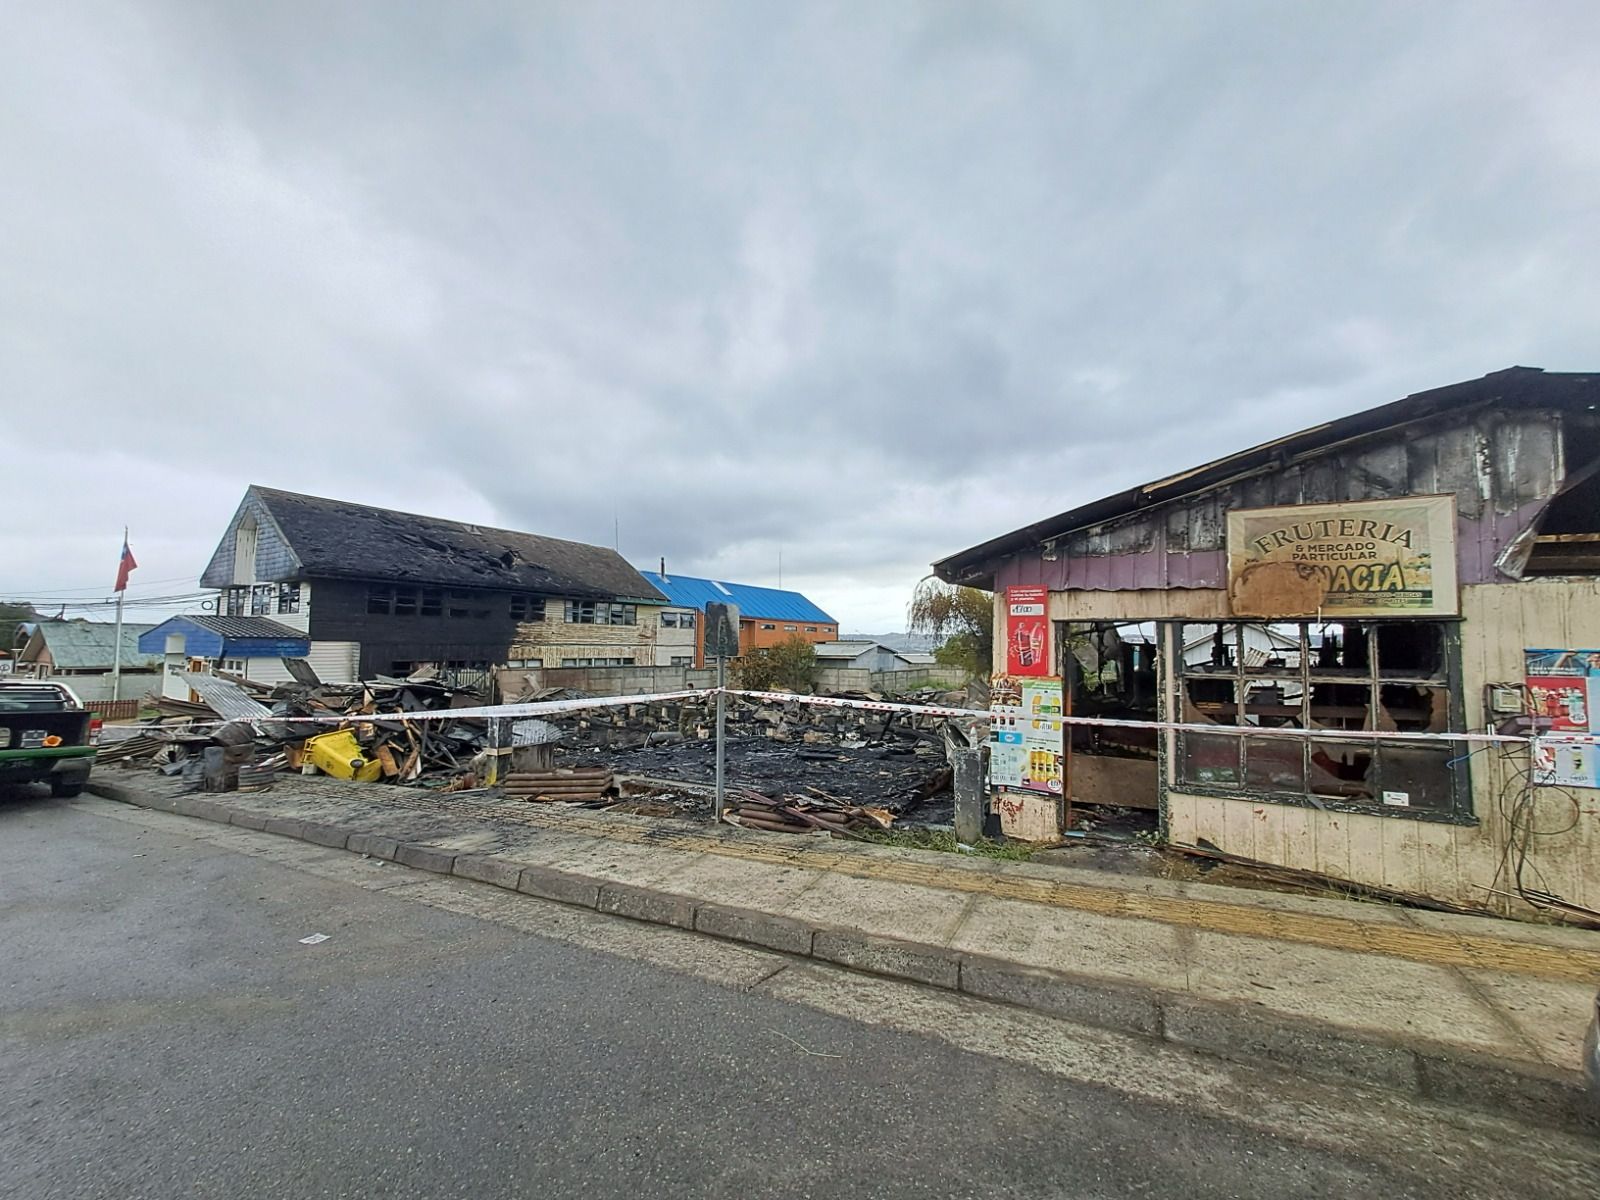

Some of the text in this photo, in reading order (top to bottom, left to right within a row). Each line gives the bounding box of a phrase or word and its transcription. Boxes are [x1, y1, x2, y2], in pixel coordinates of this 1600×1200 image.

[1255, 519, 1413, 554] FRUTERIA
[1296, 542, 1376, 553] & MERCADO
[1292, 551, 1377, 561] PARTICULAR
